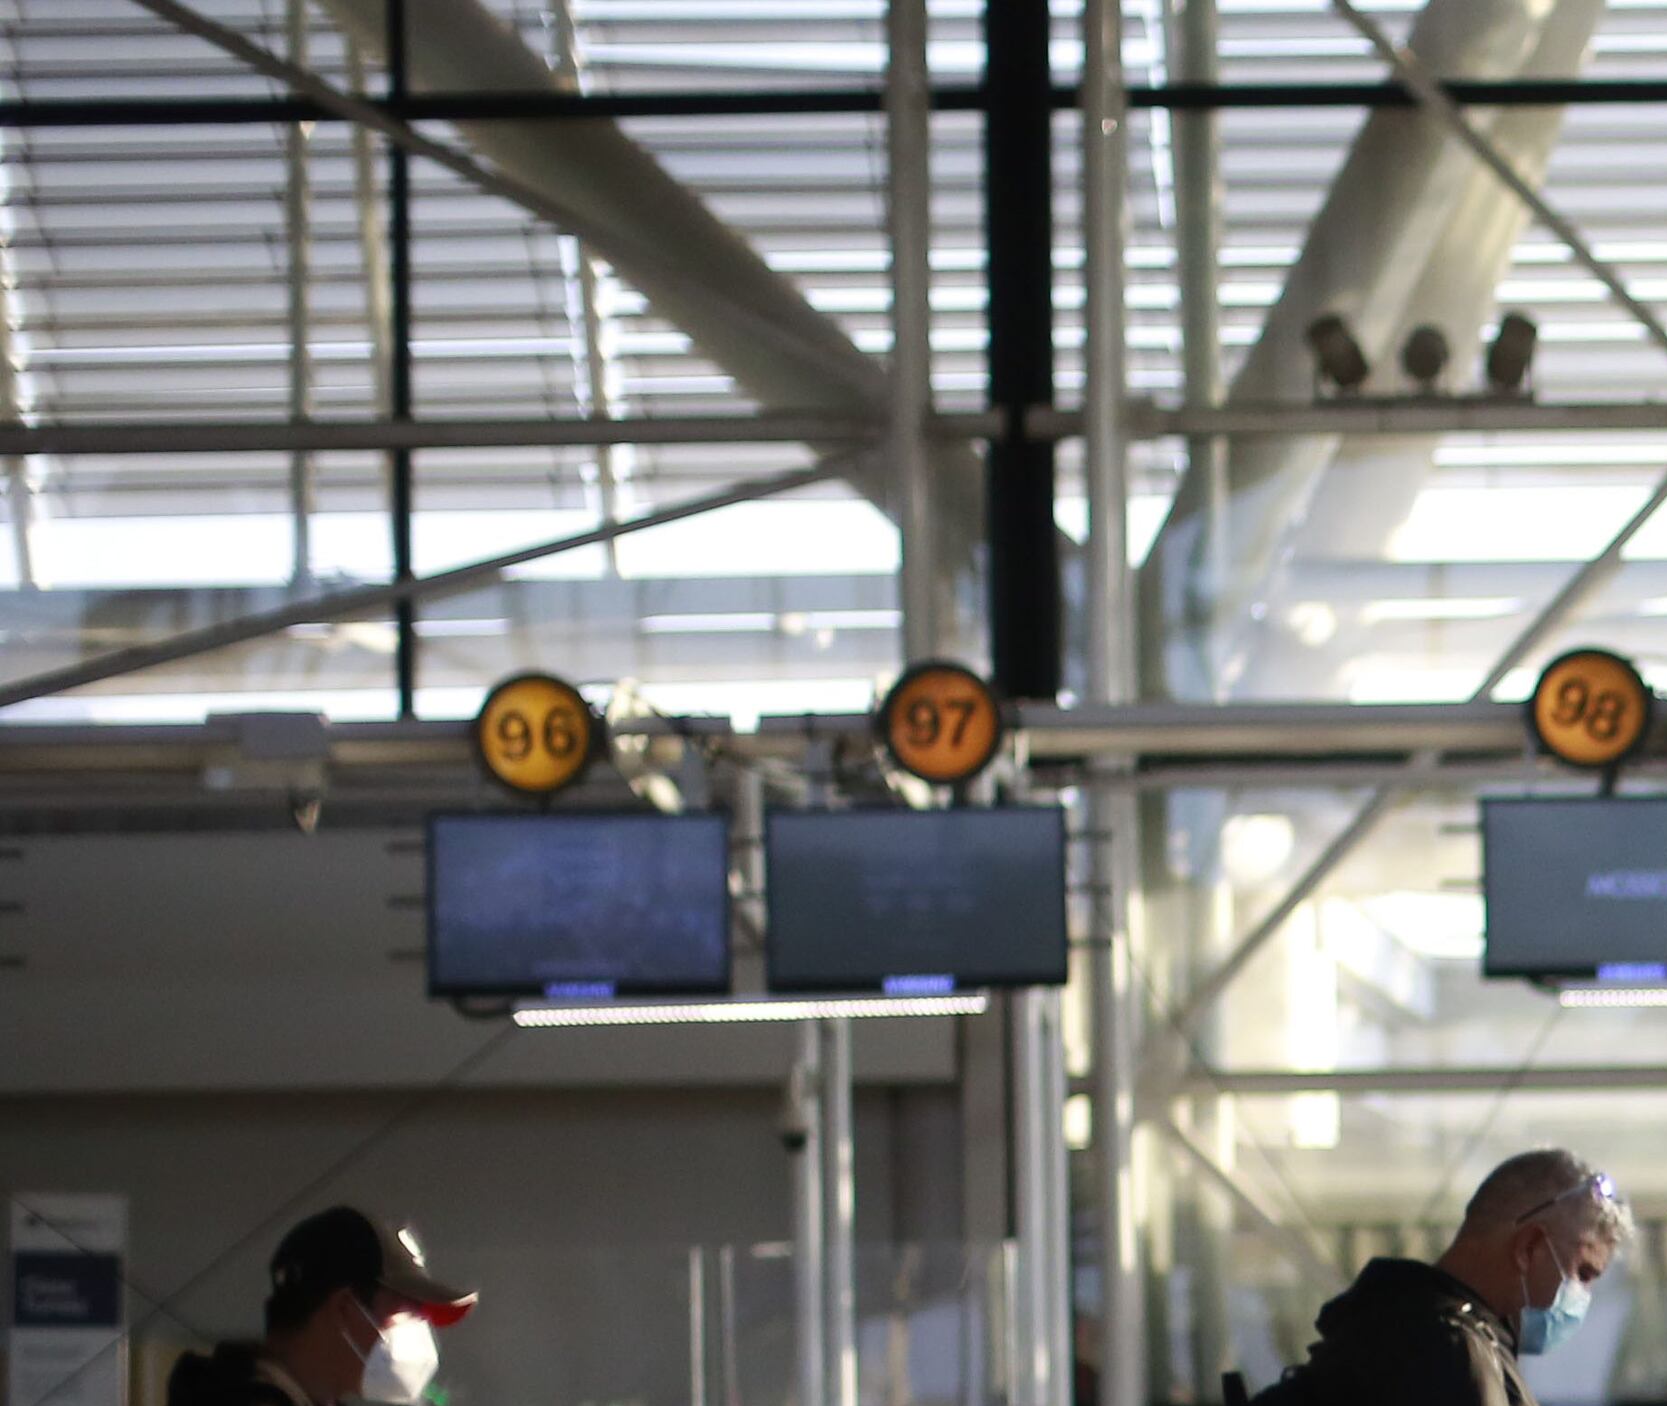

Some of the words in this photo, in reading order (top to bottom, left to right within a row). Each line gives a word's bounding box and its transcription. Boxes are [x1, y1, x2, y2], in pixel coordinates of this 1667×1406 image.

[905, 700, 977, 750] 97
[1552, 677, 1626, 742] 98
[495, 710, 580, 762] 96
